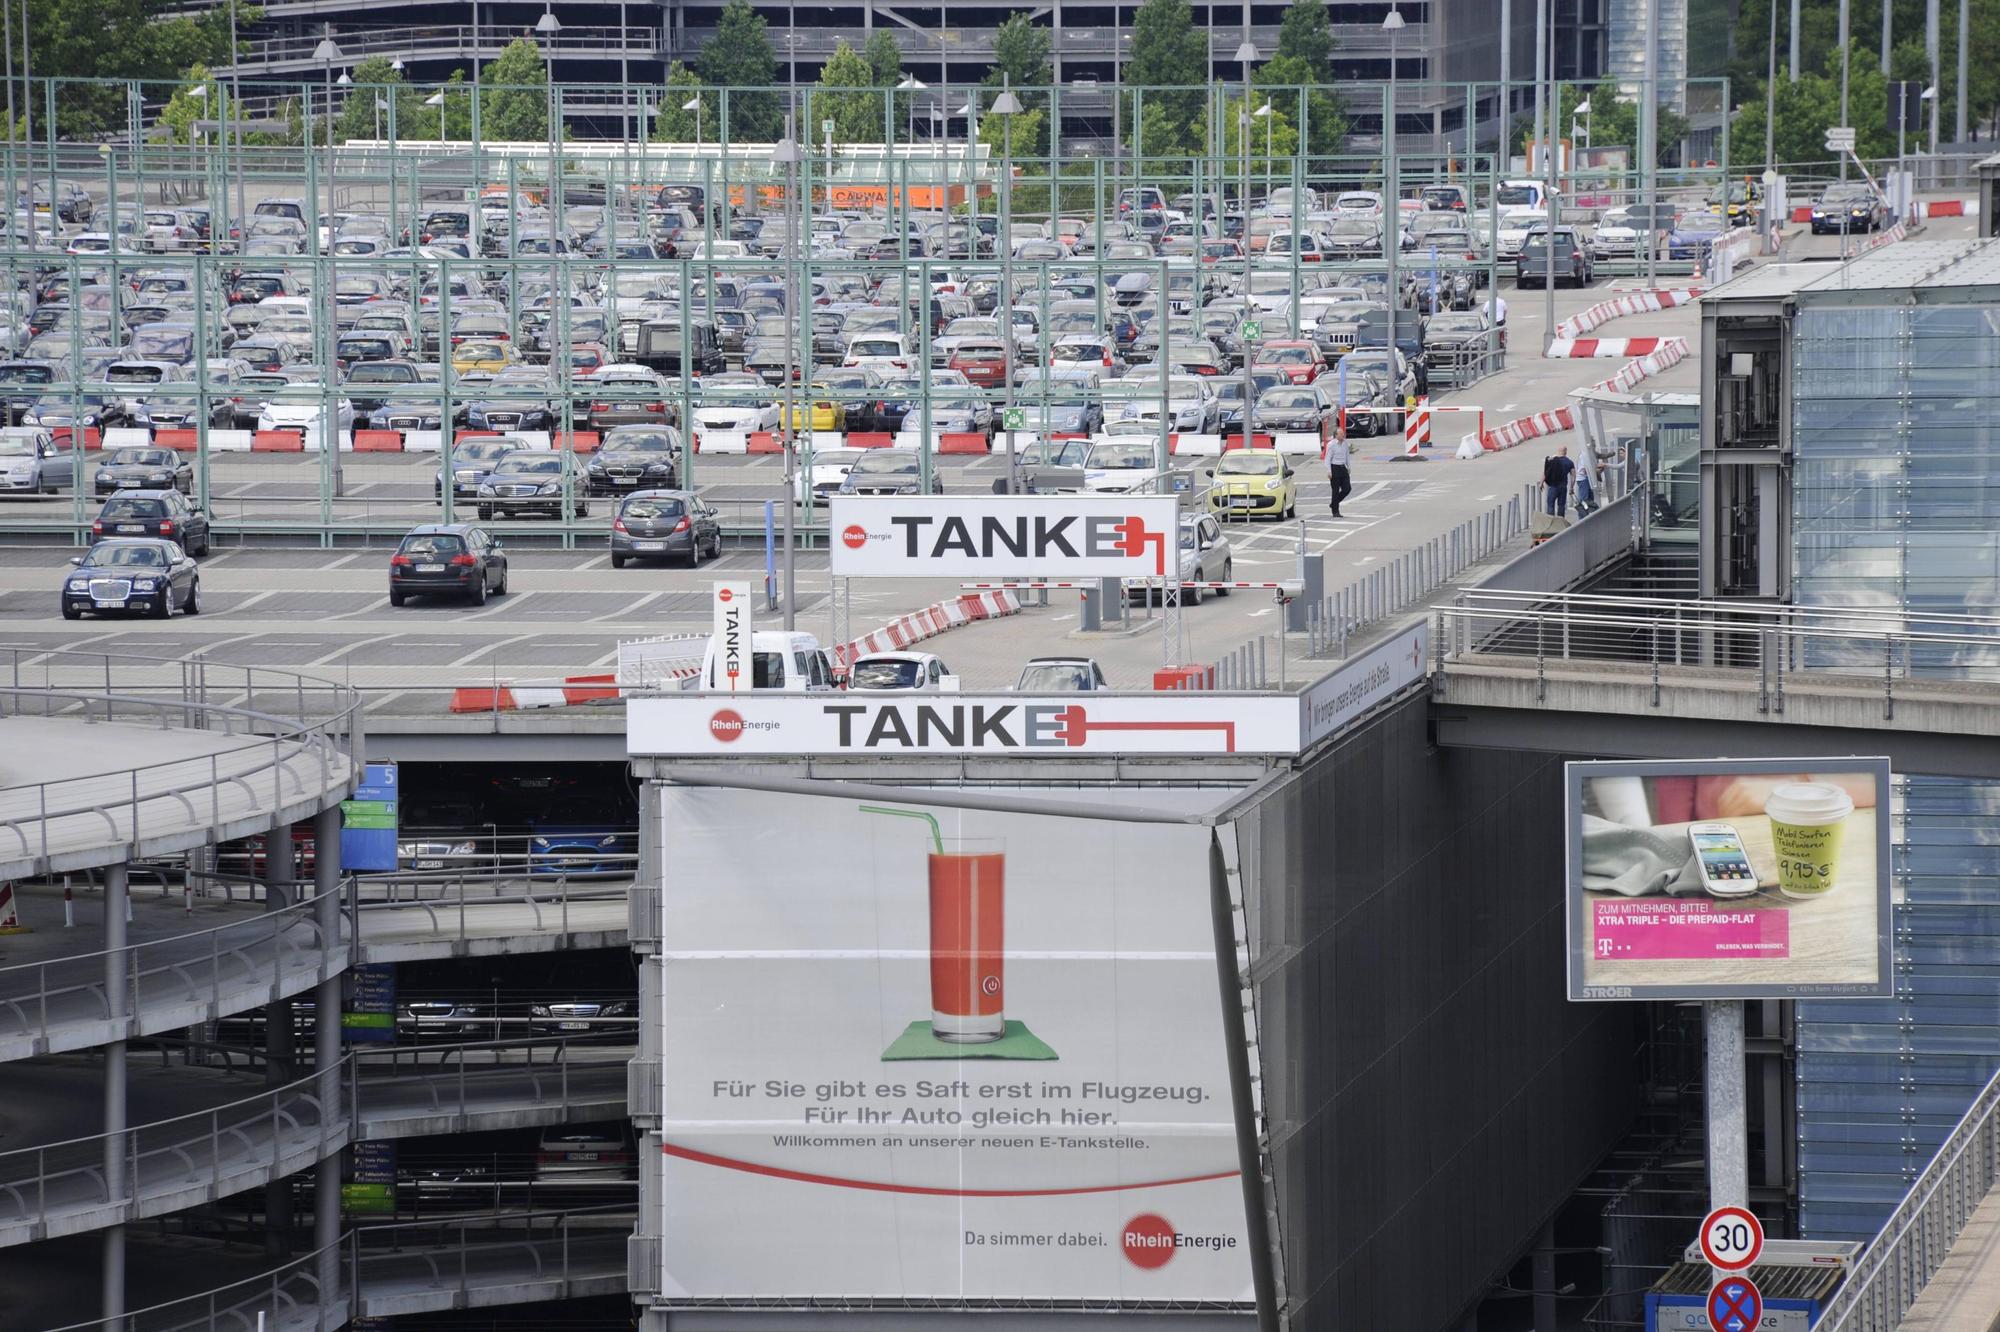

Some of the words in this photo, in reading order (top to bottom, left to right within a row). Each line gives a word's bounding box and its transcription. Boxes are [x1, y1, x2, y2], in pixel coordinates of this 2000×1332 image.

[836, 191, 900, 201] CARWAH
[844, 531, 892, 541] RheinEnergie
[891, 516, 1124, 558] TANKE
[726, 607, 739, 672] TANKE
[712, 719, 781, 731] RheinEnergie
[824, 705, 1066, 747] TANKE
[384, 768, 394, 784] 5
[1776, 827, 1797, 838] Mobil
[1799, 829, 1831, 839] Surfen
[1598, 904, 1619, 914] ZUM
[1621, 903, 1678, 914] MITNEHMEN,
[1680, 903, 1708, 913] BITTE!
[1598, 915, 1625, 926] XTRA
[1626, 915, 1660, 925] TRIPLE
[1669, 915, 1686, 925] DIE
[1687, 914, 1756, 924] PREPAID-FLAT
[1583, 985, 1632, 998] STRÖER
[713, 1080, 756, 1098] Für
[765, 1080, 806, 1098] Sie
[815, 1080, 867, 1102] gibt
[875, 1083, 907, 1098] es
[916, 1080, 970, 1098] Saft
[978, 1082, 1033, 1099] erst
[1041, 1081, 1072, 1099] im
[1082, 1082, 1210, 1105] Flugzeug.
[804, 1107, 848, 1124] Für
[858, 1107, 892, 1124] Ihr
[901, 1108, 962, 1125] Auto
[971, 1108, 1051, 1129] gleich
[1061, 1108, 1118, 1126] hier.
[773, 1135, 876, 1148] Willkommen
[882, 1137, 903, 1148] an
[909, 1137, 976, 1148] unserer
[981, 1138, 1034, 1148] neuen
[1040, 1136, 1150, 1149] E-Tankstelle.
[964, 1231, 986, 1246] Da
[990, 1231, 1054, 1247] simmer
[1057, 1232, 1108, 1247] dabei.
[1125, 1231, 1237, 1251] RheinEnergie
[1715, 1224, 1748, 1252] 30
